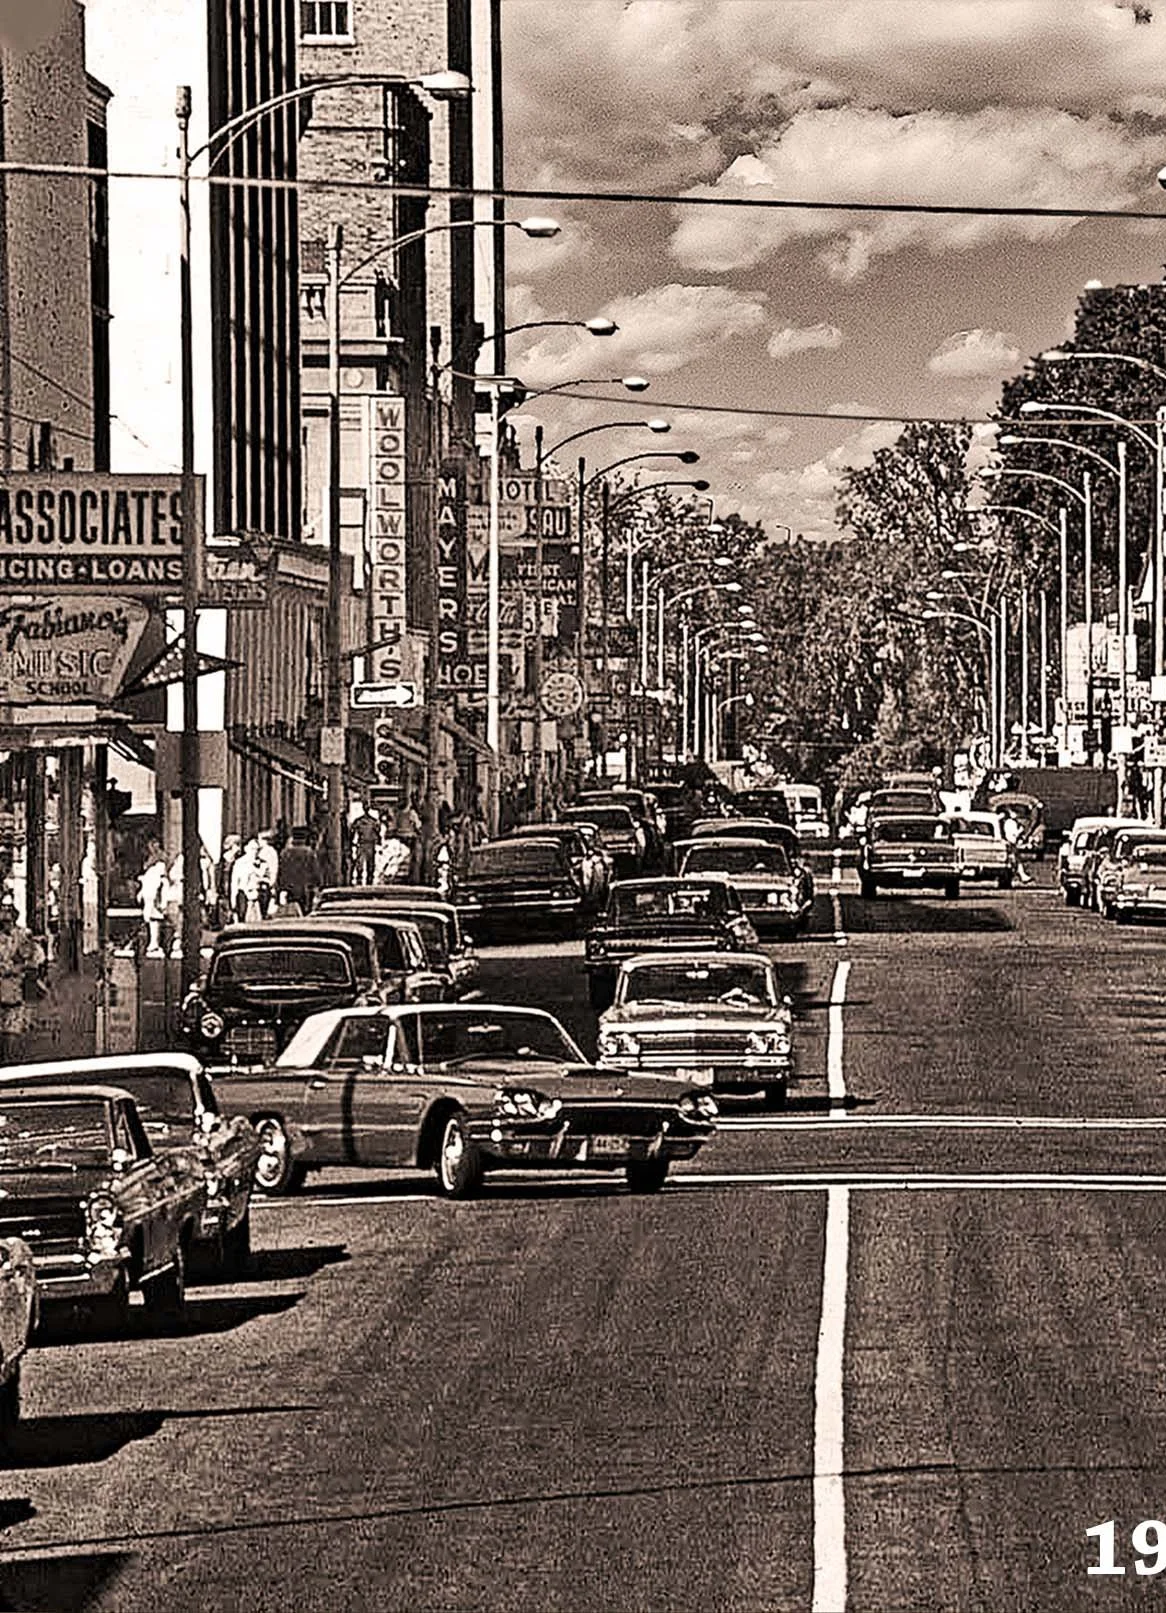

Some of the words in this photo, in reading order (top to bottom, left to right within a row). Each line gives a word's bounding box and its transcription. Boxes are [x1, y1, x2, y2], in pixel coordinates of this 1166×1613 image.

[0, 489, 184, 545] ASSOCIATES
[91, 560, 183, 580] LOANS
[437, 477, 458, 654] MAYERS
[12, 649, 113, 680] MUSIC
[25, 680, 93, 696] SCHOOL
